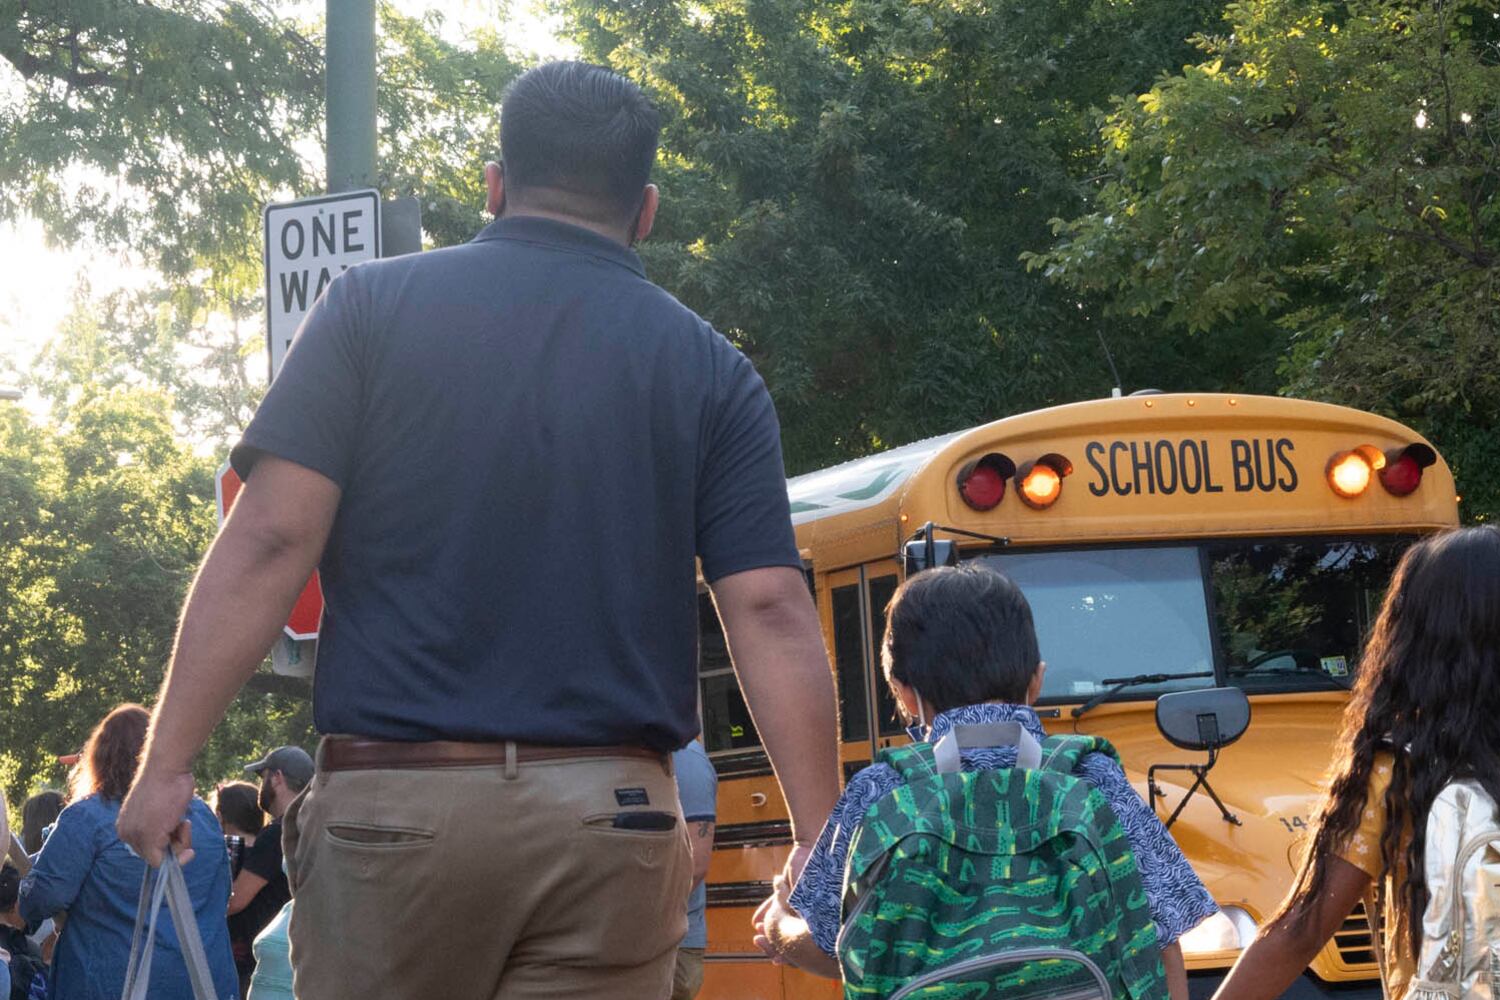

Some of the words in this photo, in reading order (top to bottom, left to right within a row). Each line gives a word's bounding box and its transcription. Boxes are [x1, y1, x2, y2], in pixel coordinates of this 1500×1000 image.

[280, 210, 365, 261] ONE
[279, 265, 348, 313] WA
[1085, 439, 1224, 497] SCHOOL
[1231, 438, 1298, 493] BUS
[1279, 814, 1311, 832] 14
